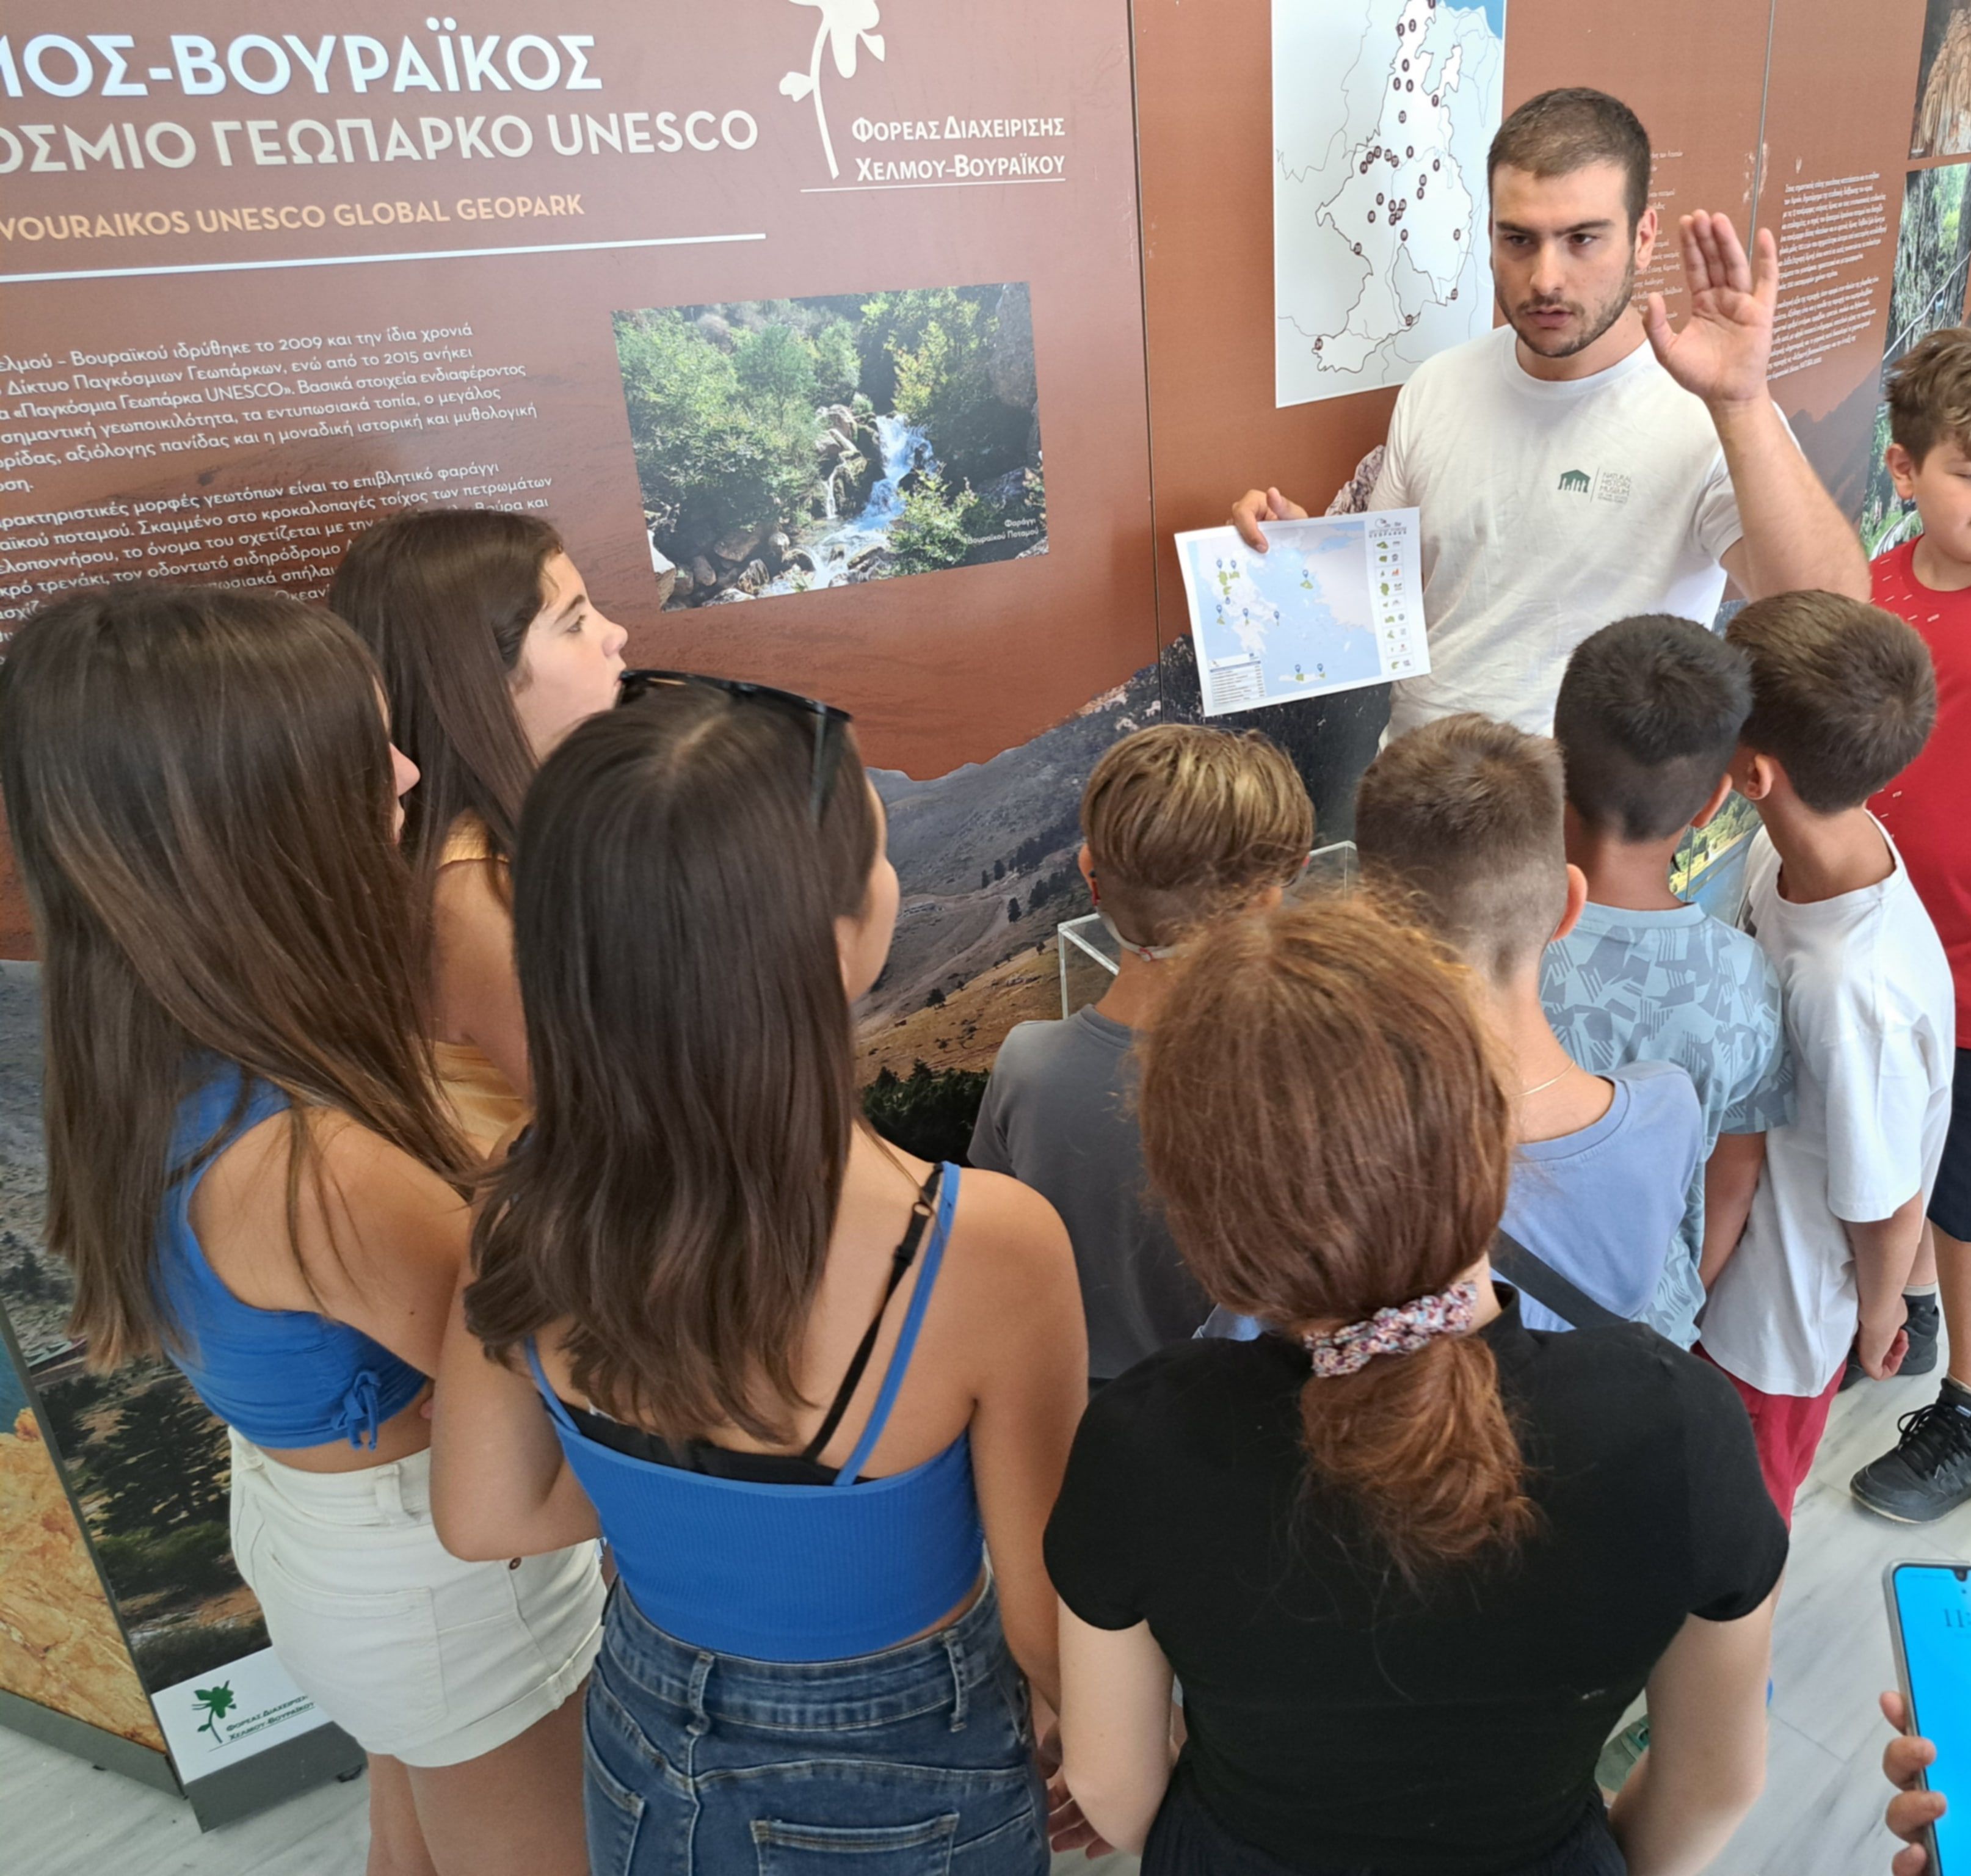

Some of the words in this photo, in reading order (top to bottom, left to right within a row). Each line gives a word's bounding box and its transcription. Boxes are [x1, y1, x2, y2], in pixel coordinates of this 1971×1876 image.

[0, 17, 602, 97] ΟΣ-ΒΟΥΡΑΪΚΟΣ
[211, 115, 534, 167] ΓΕΩΠΑΡΚΟ
[547, 109, 758, 156] UNESCO
[852, 117, 941, 142] ΦΟΡΕΑΣ
[944, 115, 1065, 139] ΔΙΑΧΕΙΡΙΣΗΣ
[0, 211, 190, 241] VOURAIKOS
[195, 205, 325, 234] UNESCO
[333, 201, 451, 227] GLOBAL
[456, 194, 585, 221] GEOPARK
[7, 379, 70, 396] Δίκτυο
[73, 371, 183, 391] Παγκόσμιων
[187, 362, 288, 381] Γεωπάρκων,
[291, 356, 322, 373] ενώ
[326, 353, 358, 369] από
[361, 355, 380, 366] το
[383, 351, 420, 365] 2015
[423, 345, 473, 363] ανήκει
[70, 344, 169, 366] Βουραϊκού
[173, 340, 251, 361] ιδρύθηκε
[256, 342, 275, 352] το
[279, 336, 322, 351] 2009
[327, 335, 352, 347] και
[355, 332, 382, 347] την
[387, 326, 417, 342] ίδια
[421, 322, 473, 343] χρονιά
[1, 421, 98, 446] σημαντική
[100, 412, 239, 438] γεωποικιλότητα,
[242, 410, 263, 421] τα
[267, 396, 371, 420] εντυπωσιακά
[374, 393, 421, 410] τοπία,
[424, 394, 434, 404] ο
[438, 386, 502, 406] μεγάλος
[13, 399, 118, 420] «Παγκόσμια
[119, 391, 204, 409] Γεωπάρκα
[205, 381, 296, 402] UNESCO».
[297, 376, 354, 394] Βασικά
[357, 371, 418, 390] στοιχεία
[421, 365, 527, 384] ενδιαφέροντος
[66, 444, 157, 463] αξιόλογης
[160, 432, 230, 453] πανίδας
[234, 433, 261, 445] και
[264, 432, 275, 445] η
[279, 420, 355, 445] μοναδική
[357, 413, 424, 433] ιστορική
[427, 413, 450, 426] και
[454, 402, 538, 426] μυθολογική
[0, 501, 129, 531] ρακτηριστικές
[133, 493, 200, 515] μορφές
[203, 487, 284, 508] γεωτόπων
[288, 481, 327, 496] είναι
[331, 480, 349, 491] το
[354, 466, 434, 489] επιβλητικό
[438, 461, 500, 481] φαράγγι
[0, 532, 49, 551] αϊκού
[54, 523, 135, 545] ποταμού.
[137, 514, 223, 536] Σκαμμένο
[227, 512, 258, 525] στο
[261, 495, 376, 522] κροκαλοπαγές
[379, 490, 429, 507] τοίχος
[432, 488, 460, 501] των
[463, 476, 553, 496] πετρωμάτων
[1004, 517, 1037, 528] Φαράγγι
[122, 547, 143, 559] το
[147, 541, 201, 556] όνομα
[205, 537, 234, 550] του
[239, 524, 321, 547] σχετίζεται
[325, 522, 345, 538] με
[348, 519, 374, 533] την
[527, 498, 549, 509] και
[1007, 526, 1039, 539] Ποταμού
[37, 572, 111, 594] τρενάκι,
[113, 570, 143, 583] τον
[147, 554, 229, 579] οδοντωτό
[233, 544, 342, 567] σιδηρόδρομο
